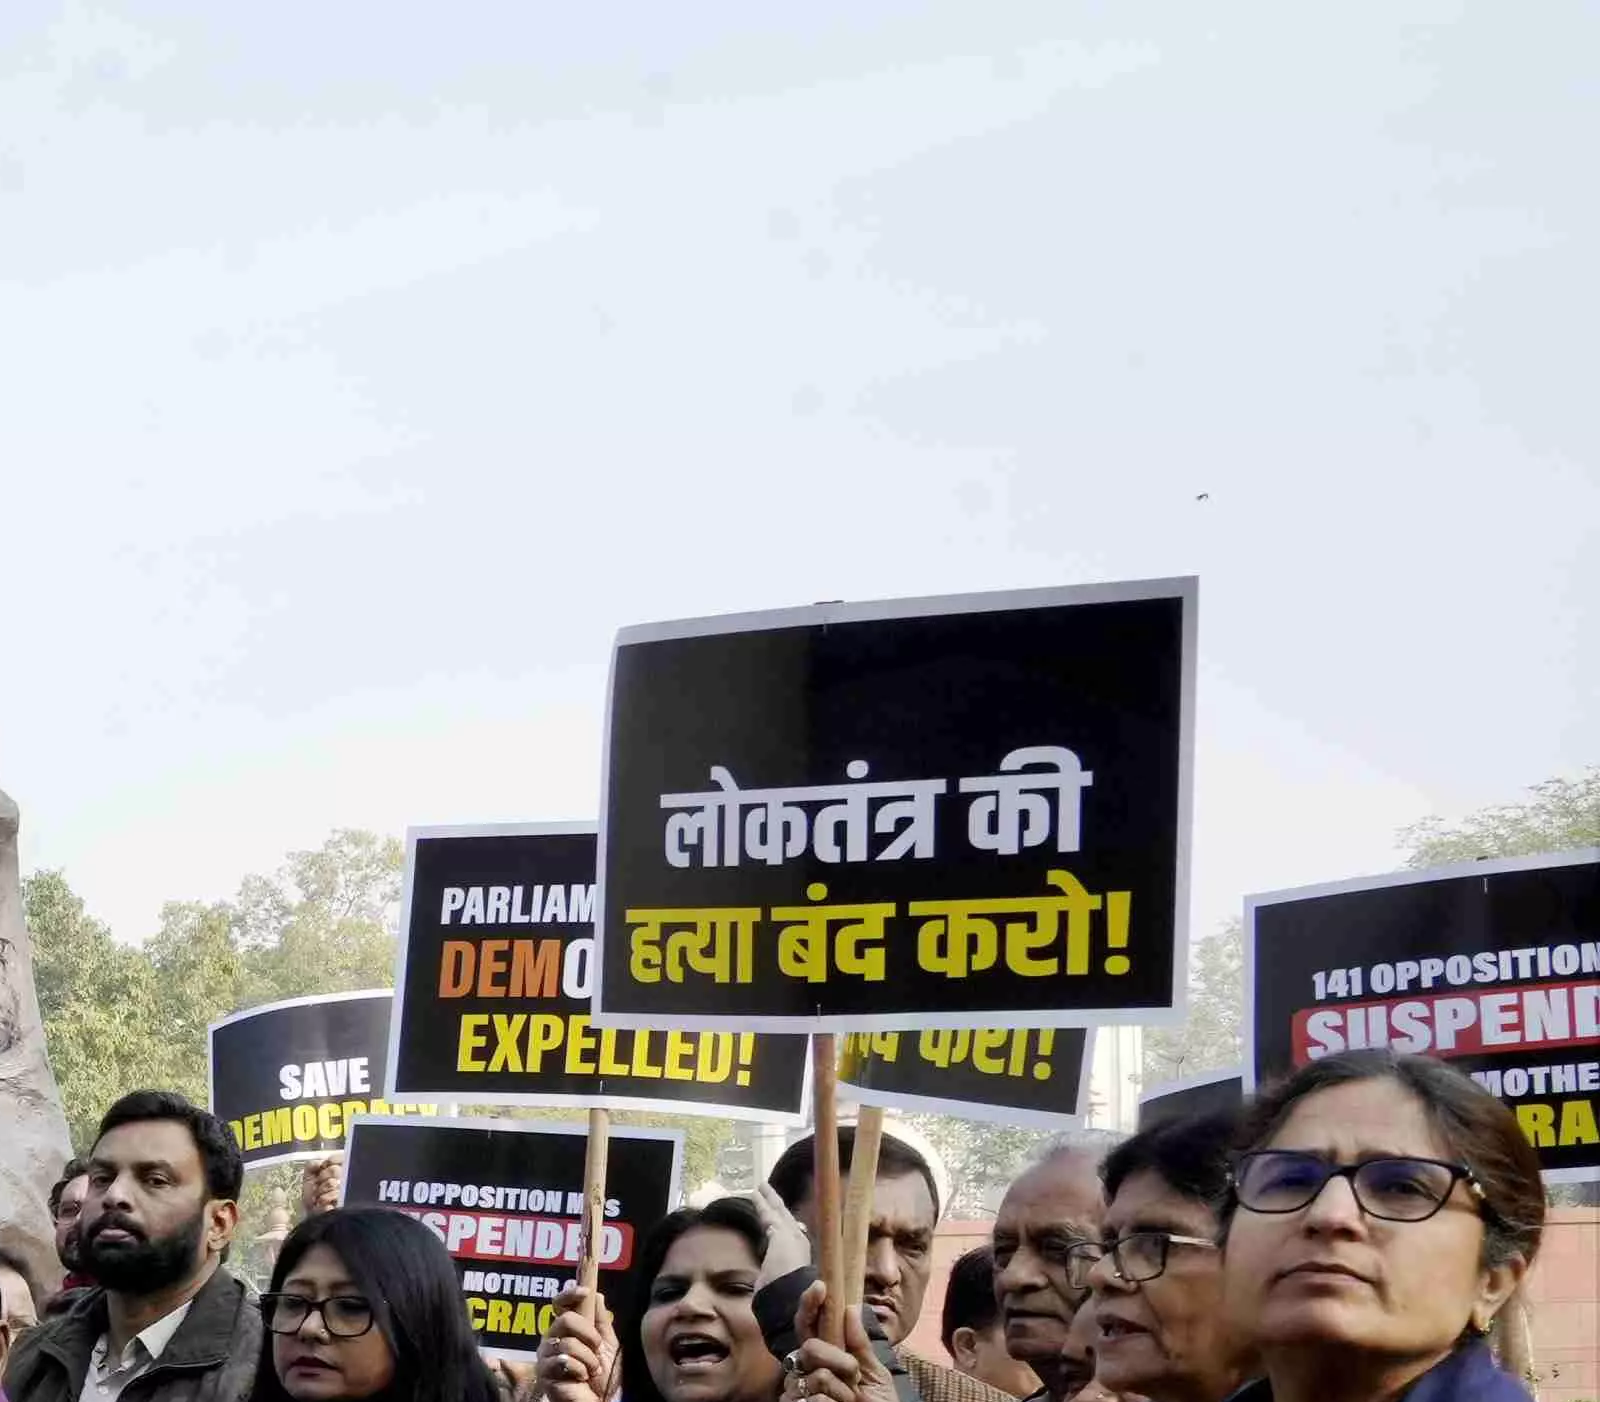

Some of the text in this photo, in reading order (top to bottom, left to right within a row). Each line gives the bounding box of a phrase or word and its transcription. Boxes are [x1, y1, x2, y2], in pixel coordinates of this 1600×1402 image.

[660, 745, 1094, 868] लोकतंत्र की
[440, 882, 598, 926] PARLIAM
[625, 906, 761, 984] हत्या
[771, 882, 896, 984] बंद
[909, 870, 1133, 979] करो!
[1312, 966, 1363, 1000] 141
[456, 1013, 755, 1087] EXPELLED!
[279, 1057, 371, 1100] SAVE
[1471, 1062, 1600, 1098] MOTHE
[378, 1179, 410, 1203] 141
[413, 1182, 562, 1214] OPPOSITION
